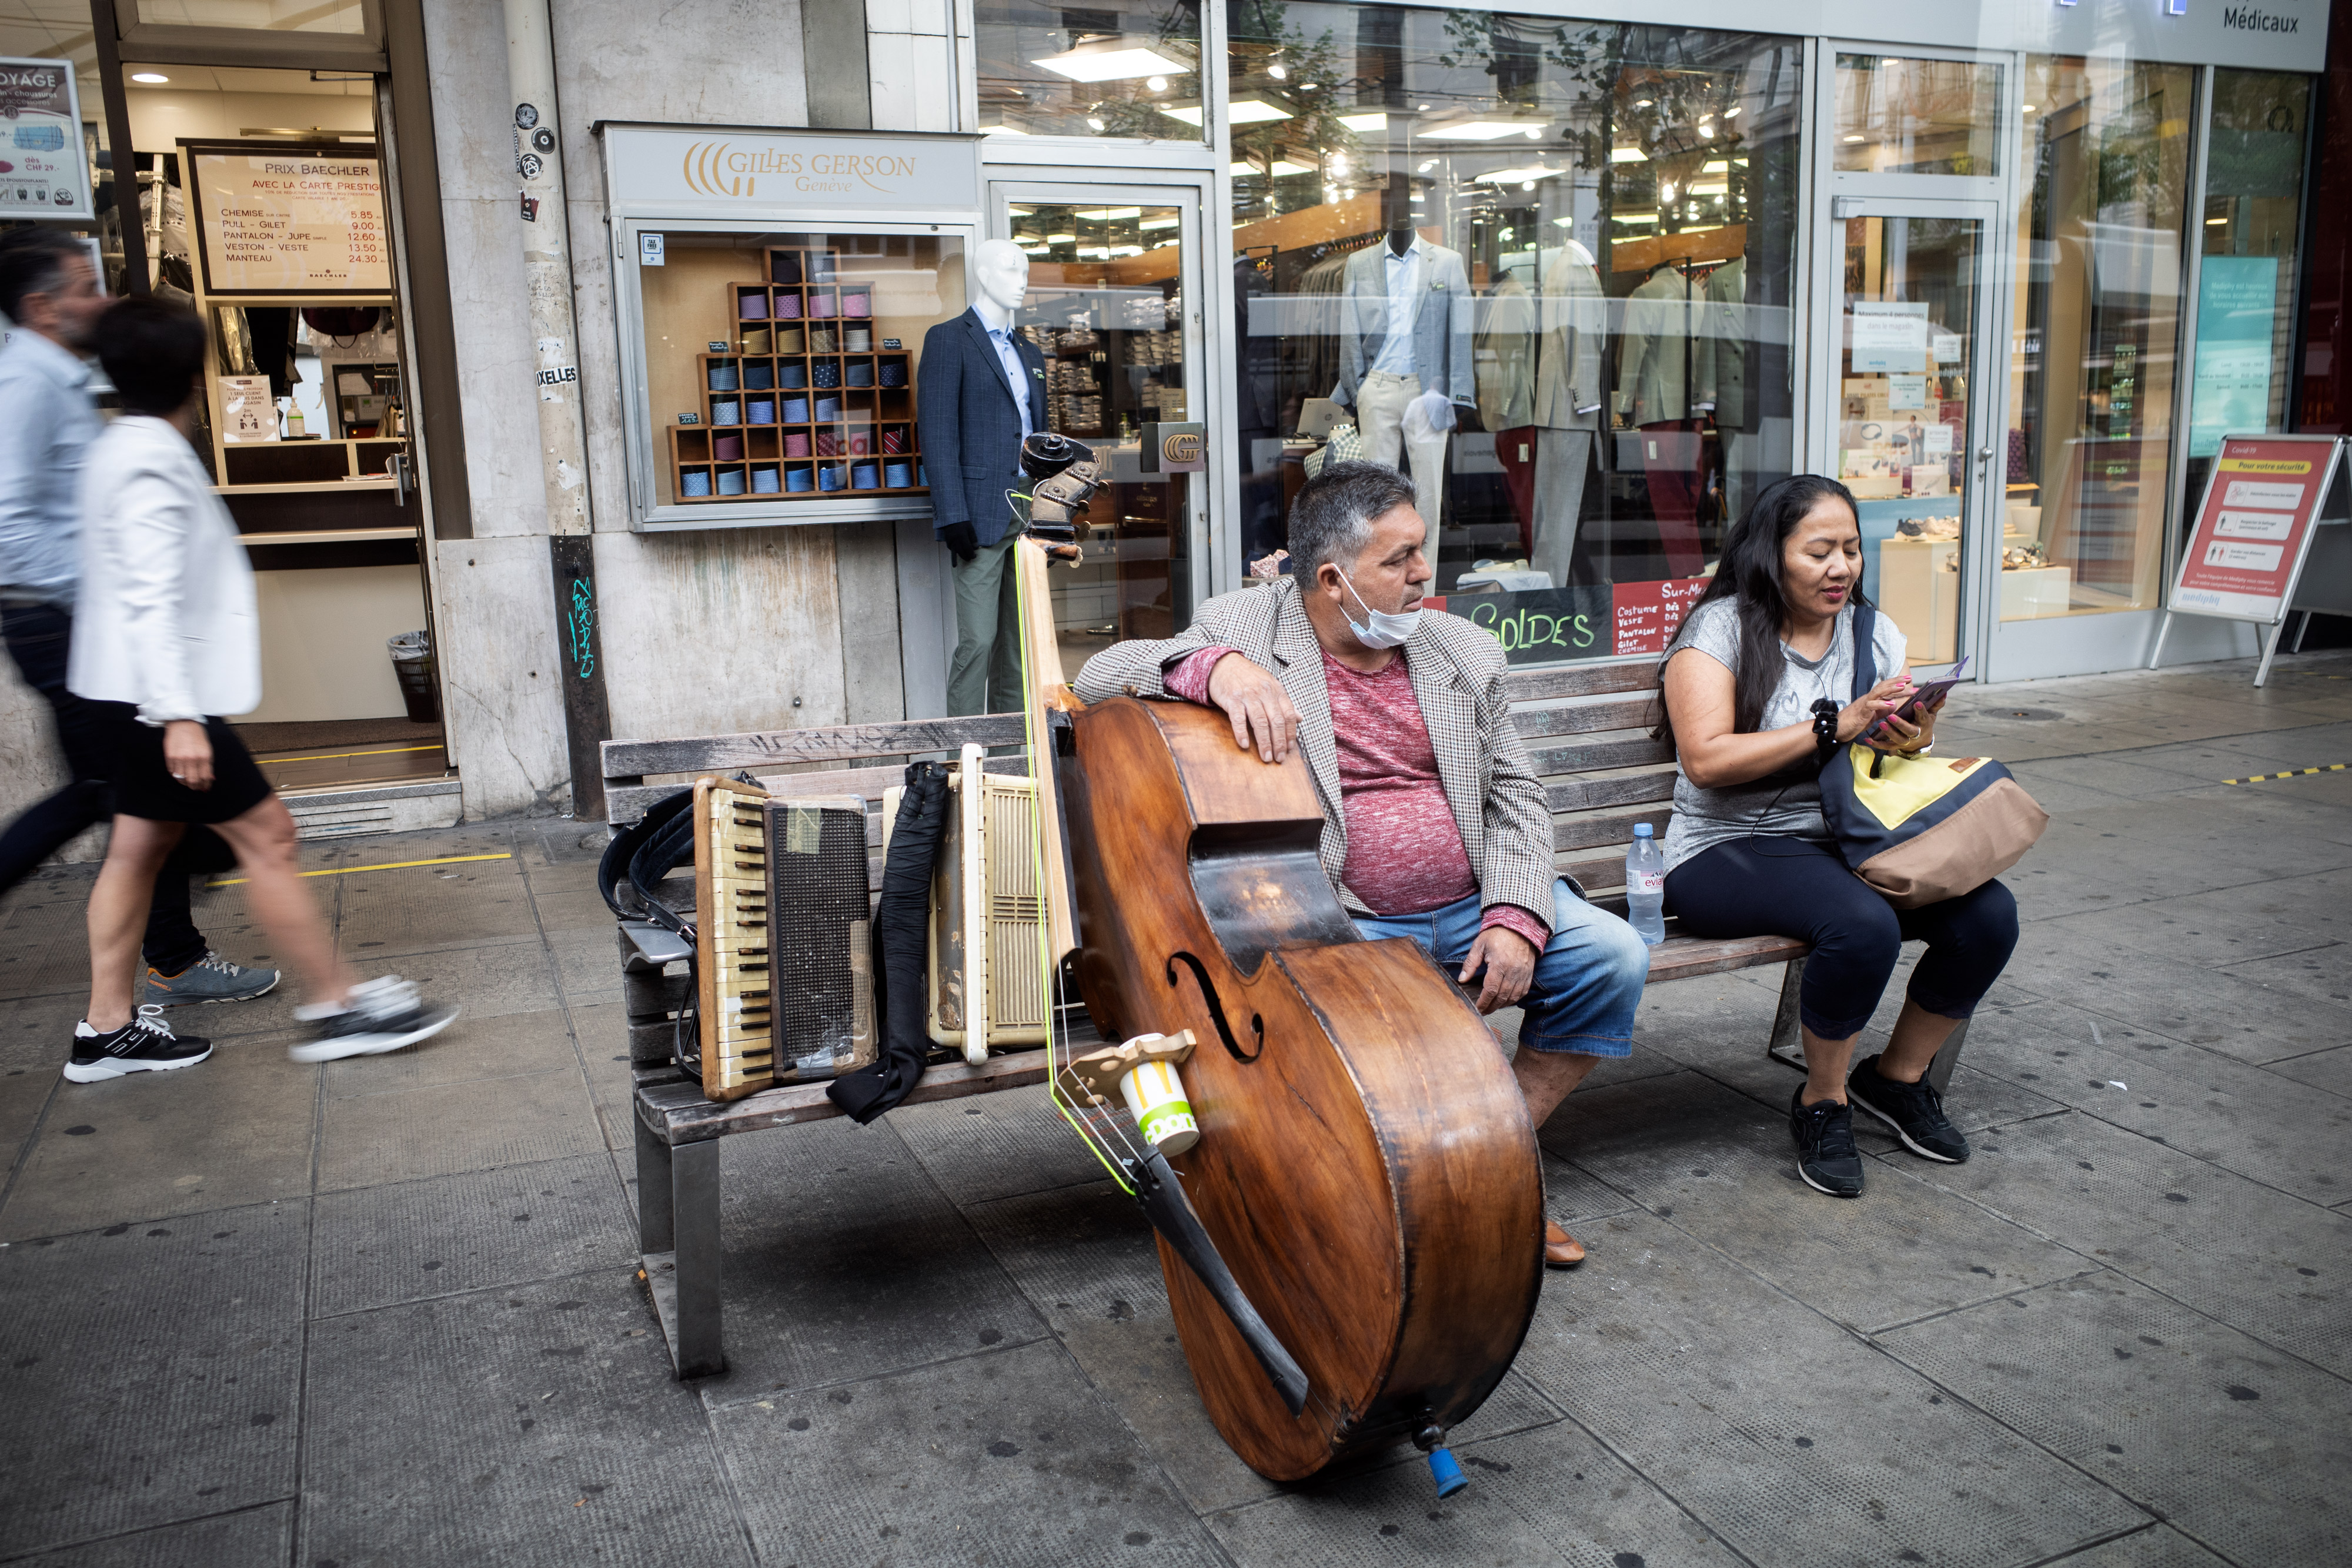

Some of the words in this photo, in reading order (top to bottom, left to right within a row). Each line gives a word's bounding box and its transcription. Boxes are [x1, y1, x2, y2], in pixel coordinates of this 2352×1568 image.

[2224, 6, 2298, 34] Médicaux
[0, 73, 56, 87] OYAGE
[15, 90, 57, 99] chaussures
[266, 163, 295, 174] PRIX
[302, 165, 369, 175] BAECHLER
[727, 148, 803, 173] GILLES
[811, 154, 917, 192] GERSON
[253, 180, 278, 188] AVEC
[338, 182, 381, 190] PRESTIG
[795, 176, 853, 192] Genève
[221, 209, 264, 217] CHEMISE
[349, 255, 377, 263] 24.30
[536, 367, 576, 387] IXELLES
[2193, 437, 2220, 448] mediph
[2276, 463, 2305, 471] sécurité
[2181, 593, 2220, 606] mediphy
[1471, 603, 1594, 652] SOLDES
[149, 978, 172, 992] MERRELL
